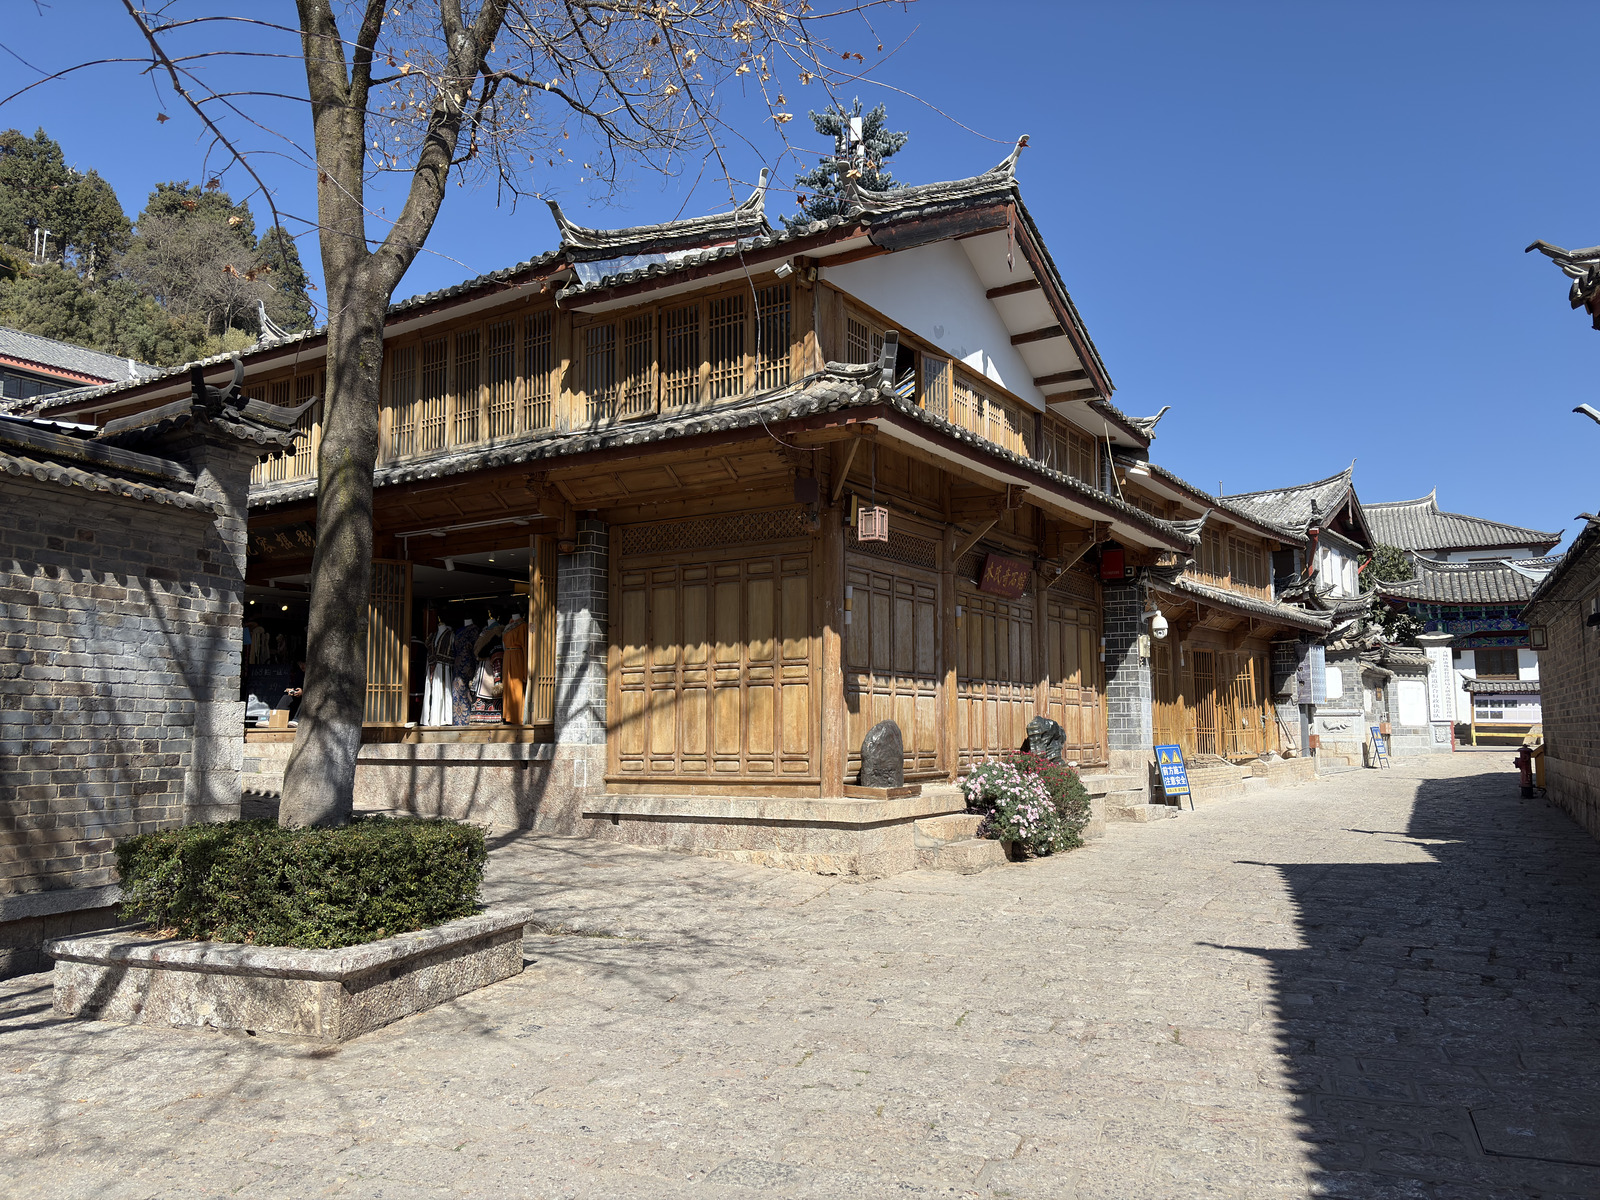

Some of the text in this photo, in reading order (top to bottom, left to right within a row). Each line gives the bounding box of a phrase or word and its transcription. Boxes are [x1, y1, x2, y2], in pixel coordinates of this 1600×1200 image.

[1162, 766, 1184, 776] 前方施工
[1164, 776, 1187, 786] 注意安全
